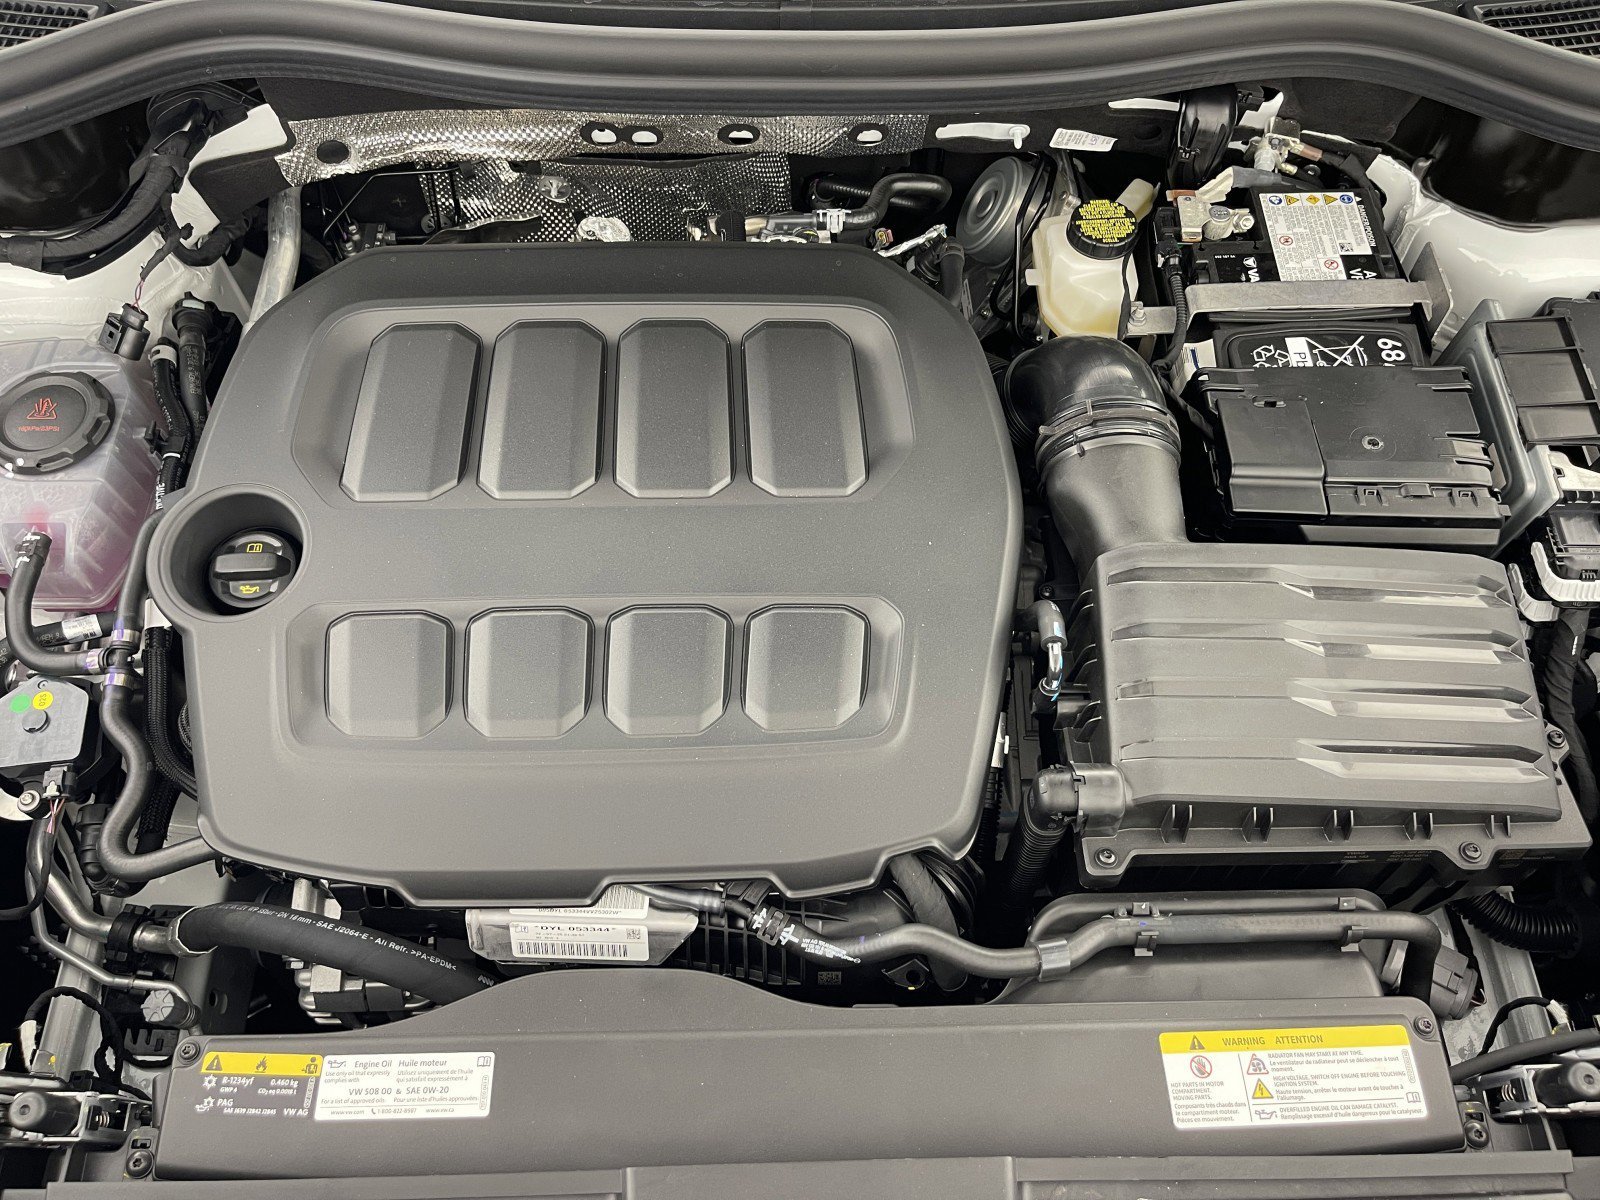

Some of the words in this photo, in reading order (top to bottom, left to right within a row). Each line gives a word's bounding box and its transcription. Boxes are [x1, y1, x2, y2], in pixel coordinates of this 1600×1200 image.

[316, 921, 335, 930] SAE
[334, 926, 369, 940] J2064-E
[389, 941, 408, 954] Refr.
[410, 949, 456, 970] >PA-EPDM<
[1222, 1036, 1266, 1046] WARNING
[1275, 1035, 1324, 1044] ATTENTION
[354, 1061, 380, 1069] Engine
[222, 1077, 254, 1087] R-1234yf
[290, 1079, 299, 1087] kg
[217, 1099, 234, 1107] PAG
